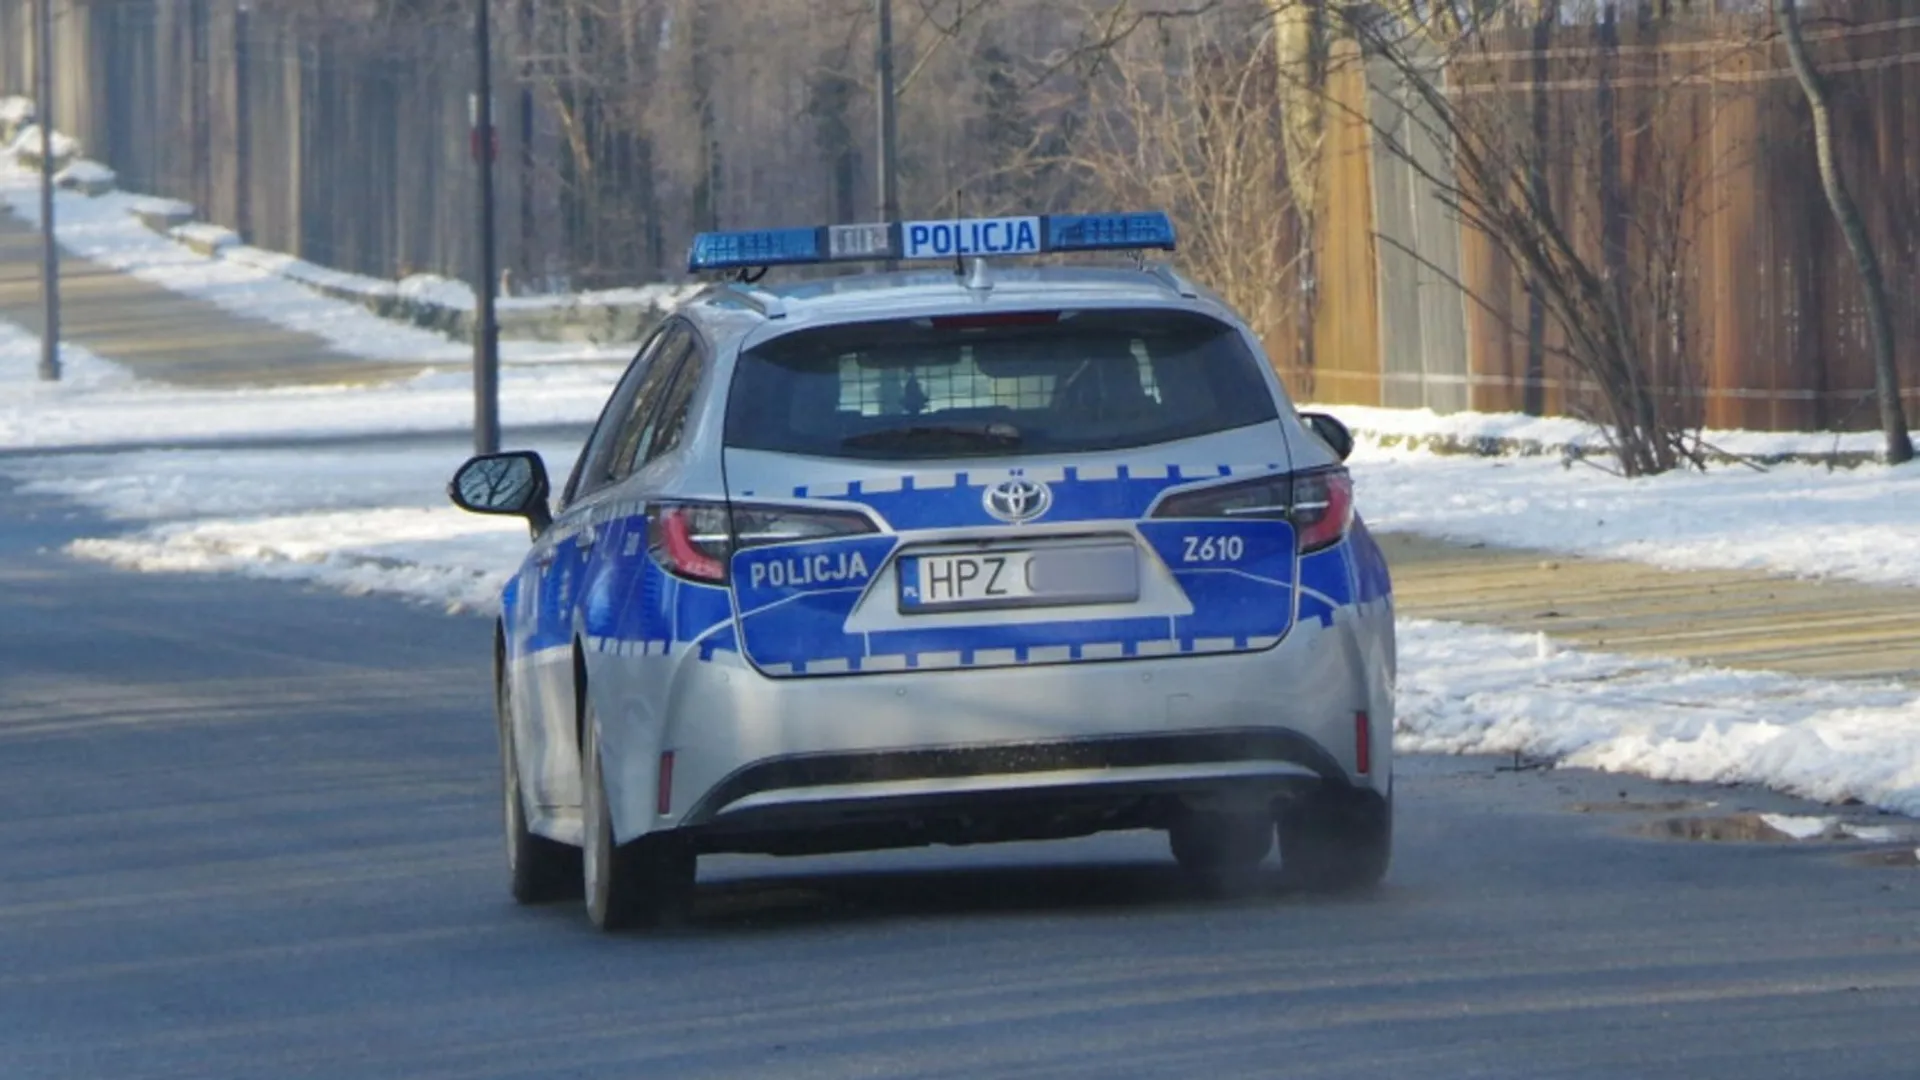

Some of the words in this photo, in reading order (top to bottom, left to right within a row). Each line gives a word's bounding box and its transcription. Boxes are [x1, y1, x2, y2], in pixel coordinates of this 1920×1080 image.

[910, 221, 1036, 255] POLICJA
[1183, 536, 1244, 561] Z610
[751, 552, 868, 589] POLICJA
[928, 556, 1008, 599] HPZ
